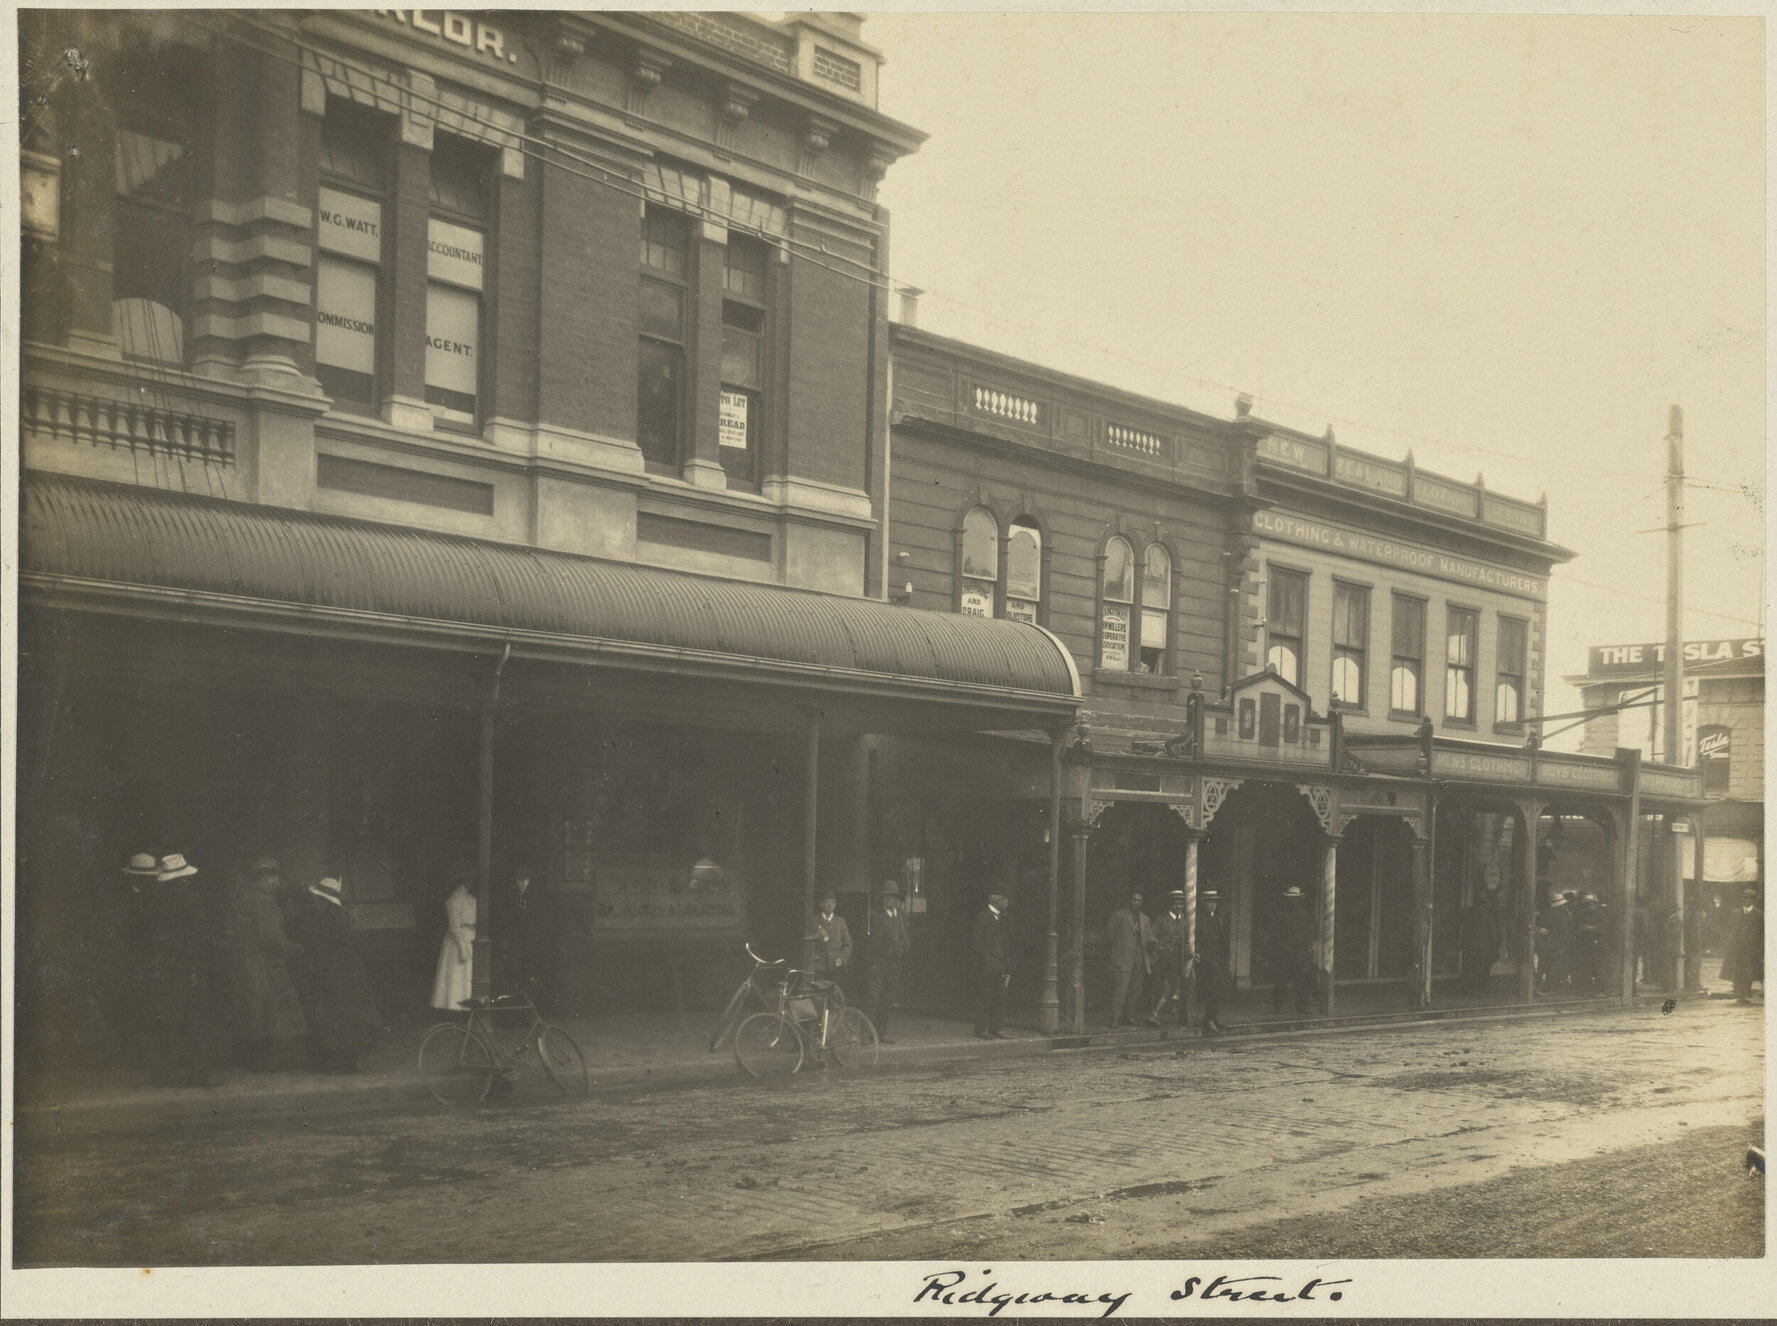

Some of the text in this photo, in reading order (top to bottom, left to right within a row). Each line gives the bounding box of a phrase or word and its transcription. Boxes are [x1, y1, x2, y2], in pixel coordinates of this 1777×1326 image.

[317, 310, 374, 337] OMMISSION
[426, 335, 473, 357] AGENT.
[1267, 437, 1306, 461] NEW
[1253, 513, 1330, 544] CLOTHING
[1333, 533, 1345, 547] &
[1349, 536, 1435, 569] WATERPROOF
[967, 598, 982, 606] AND
[1010, 602, 1025, 610] AND
[1599, 645, 1643, 665] THE
[1653, 641, 1734, 663] TSLA
[1699, 732, 1730, 754] Tesla
[1469, 756, 1521, 776] CLOTHING
[1542, 765, 1569, 780] BOYS
[913, 1268, 1134, 1319] Ridgway
